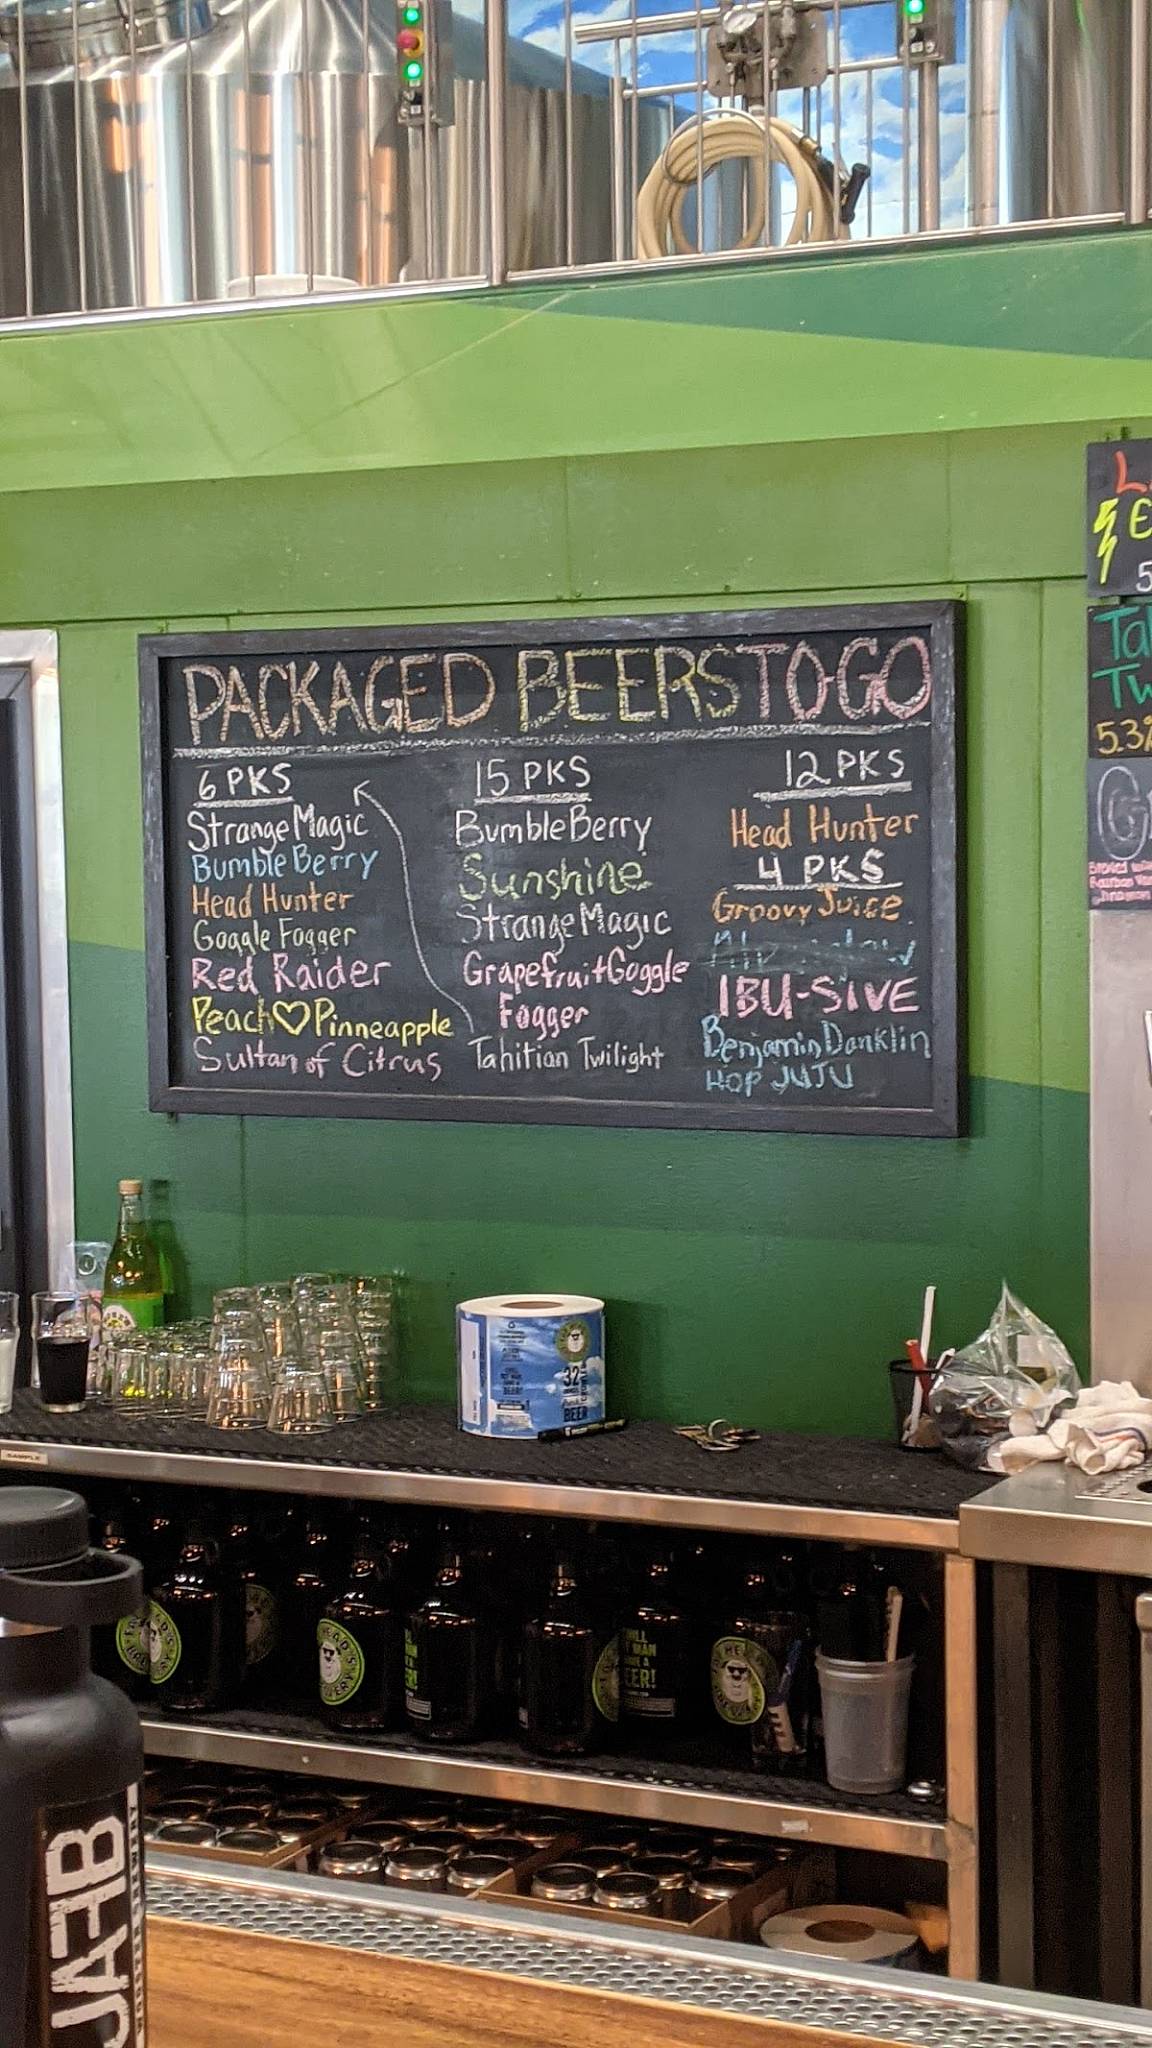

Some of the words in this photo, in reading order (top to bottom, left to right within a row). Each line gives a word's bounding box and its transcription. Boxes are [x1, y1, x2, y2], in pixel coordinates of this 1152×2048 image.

[183, 652, 496, 745] PACKAGED
[517, 643, 741, 733] BEERS
[736, 636, 932, 721] TO-GO
[199, 770, 216, 799] 6
[227, 763, 292, 796] PKS
[476, 758, 510, 796] 15
[524, 755, 591, 790] PKS
[786, 750, 831, 788] 12
[838, 749, 905, 780] PKS
[731, 808, 793, 850] Head
[809, 803, 919, 844] Hunter
[459, 852, 653, 901] Sunshine
[758, 855, 784, 885] 4
[804, 848, 885, 884] PKS
[192, 883, 252, 919] Head
[263, 881, 354, 914] Hunter
[279, 918, 357, 956] Fogger
[192, 956, 259, 994] Red
[272, 952, 392, 993] Raider
[499, 991, 589, 1041] Fogger
[193, 1036, 299, 1074] Sultan
[305, 1042, 336, 1079] of
[342, 1043, 442, 1082] Citrus
[467, 1036, 568, 1072] Tahitian
[577, 1036, 664, 1073] Twilight
[706, 1069, 764, 1097] HOP
[771, 1060, 854, 1094] JUJU
[563, 1366, 579, 1386] 32
